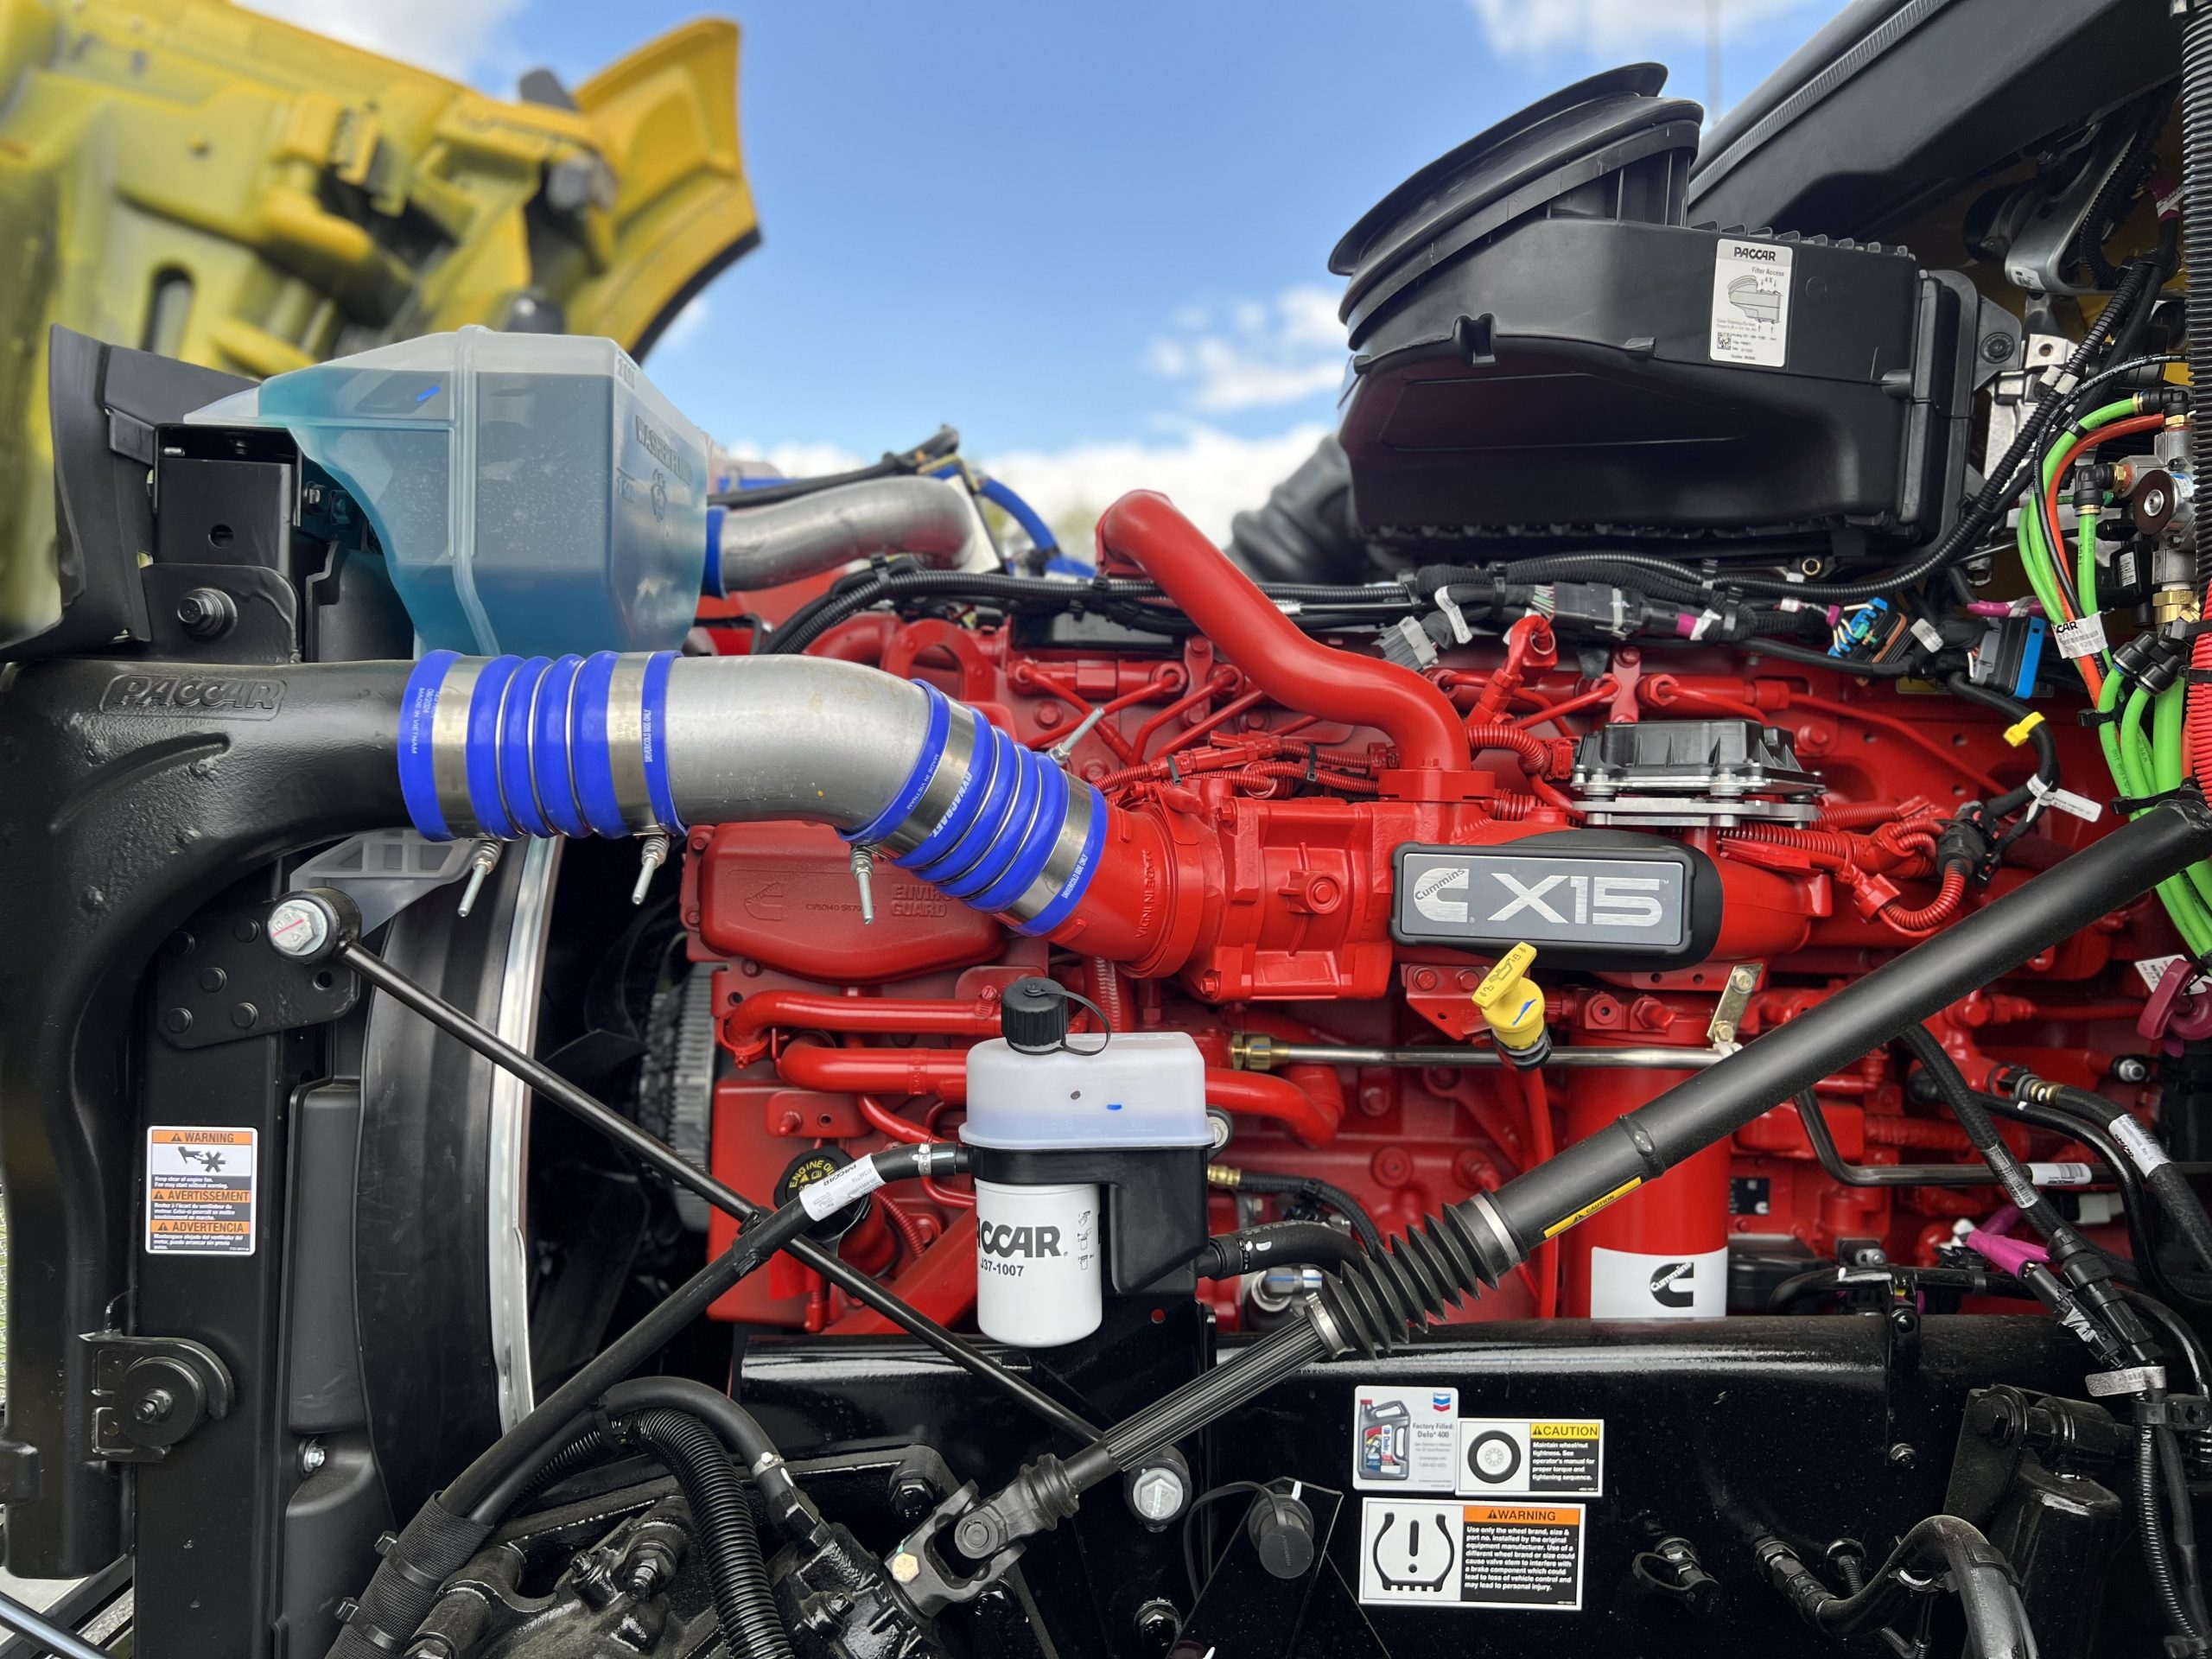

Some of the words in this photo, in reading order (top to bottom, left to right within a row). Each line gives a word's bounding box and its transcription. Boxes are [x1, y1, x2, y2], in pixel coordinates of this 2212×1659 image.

[1734, 247, 1776, 262] PACCAR
[114, 675, 280, 709] PACCAR
[415, 688, 425, 709] MADE
[411, 720, 420, 753] VIETNAM
[928, 753, 939, 774] MADE
[906, 782, 926, 810] VIETNAM
[1142, 849, 1156, 888] MADE
[892, 884, 953, 901] ENVIR
[1414, 868, 1465, 901] Cummins
[1144, 890, 1155, 904] IN
[1487, 873, 1663, 927] X15
[891, 900, 947, 918] GUARD
[1135, 906, 1153, 938] INDIA
[185, 1133, 233, 1142] WARNING
[789, 1160, 824, 1189] ENGINE
[823, 1163, 835, 1176] OIL
[823, 1163, 856, 1185] PACCAR
[168, 1191, 249, 1201] AVERTISSEMENT
[1586, 1195, 1614, 1213] CAUTION
[173, 1222, 244, 1232] ADVERTENCIA
[977, 1217, 1061, 1258] CCAR
[1650, 1262, 1692, 1292] Cummins
[1543, 1426, 1598, 1436] CAUTION
[1498, 1510, 1555, 1521] WARNING
[1532, 1584, 1553, 1592] injury.
